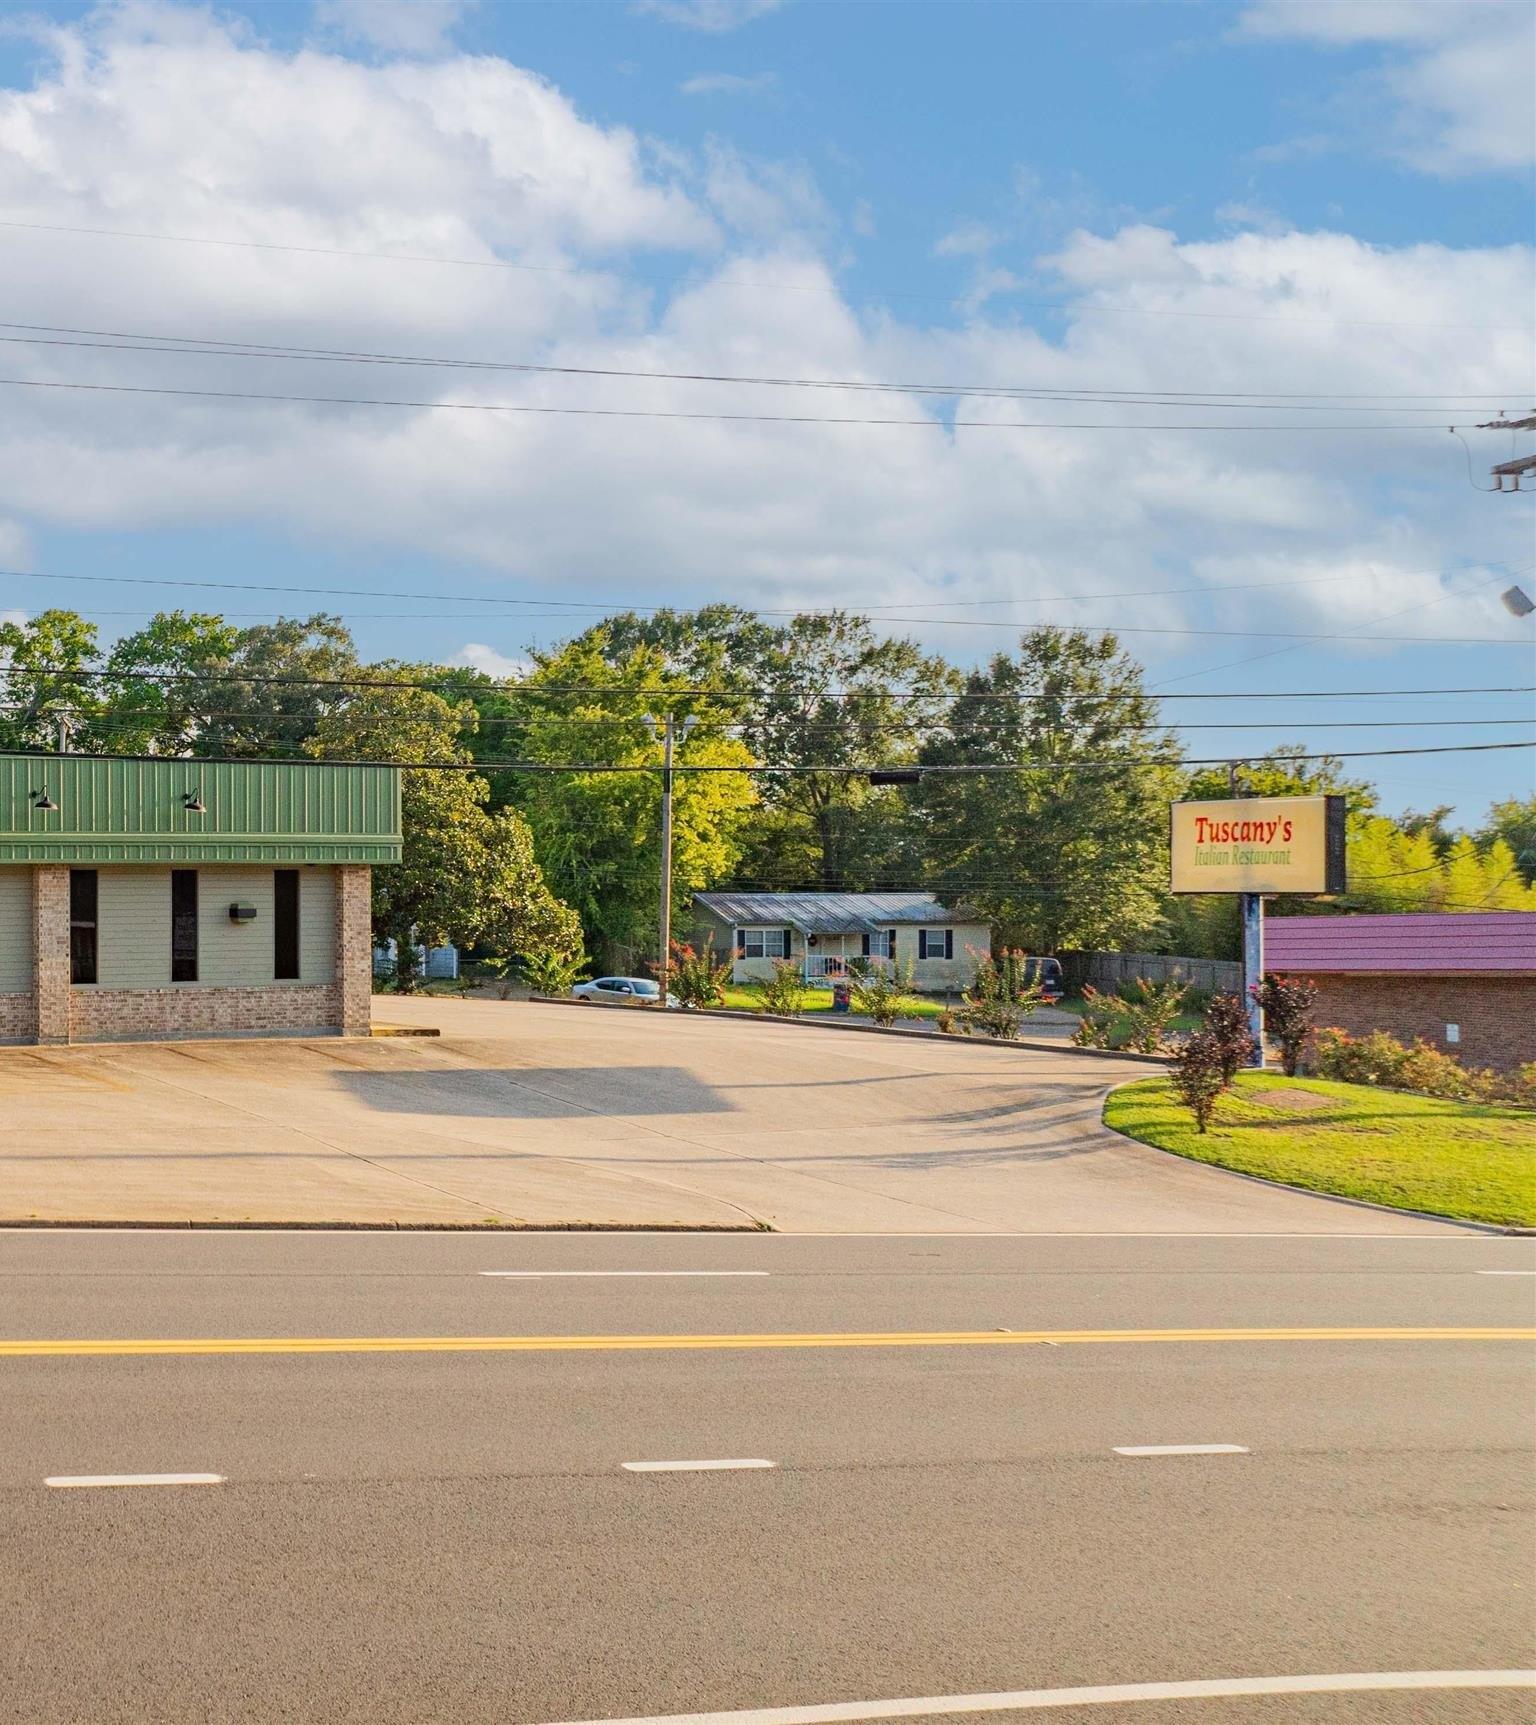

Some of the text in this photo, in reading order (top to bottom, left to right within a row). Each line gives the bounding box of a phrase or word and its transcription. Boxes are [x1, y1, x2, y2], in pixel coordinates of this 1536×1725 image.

[1195, 815, 1292, 844] Tuscany's
[1194, 845, 1291, 866] Italian Restaurant
